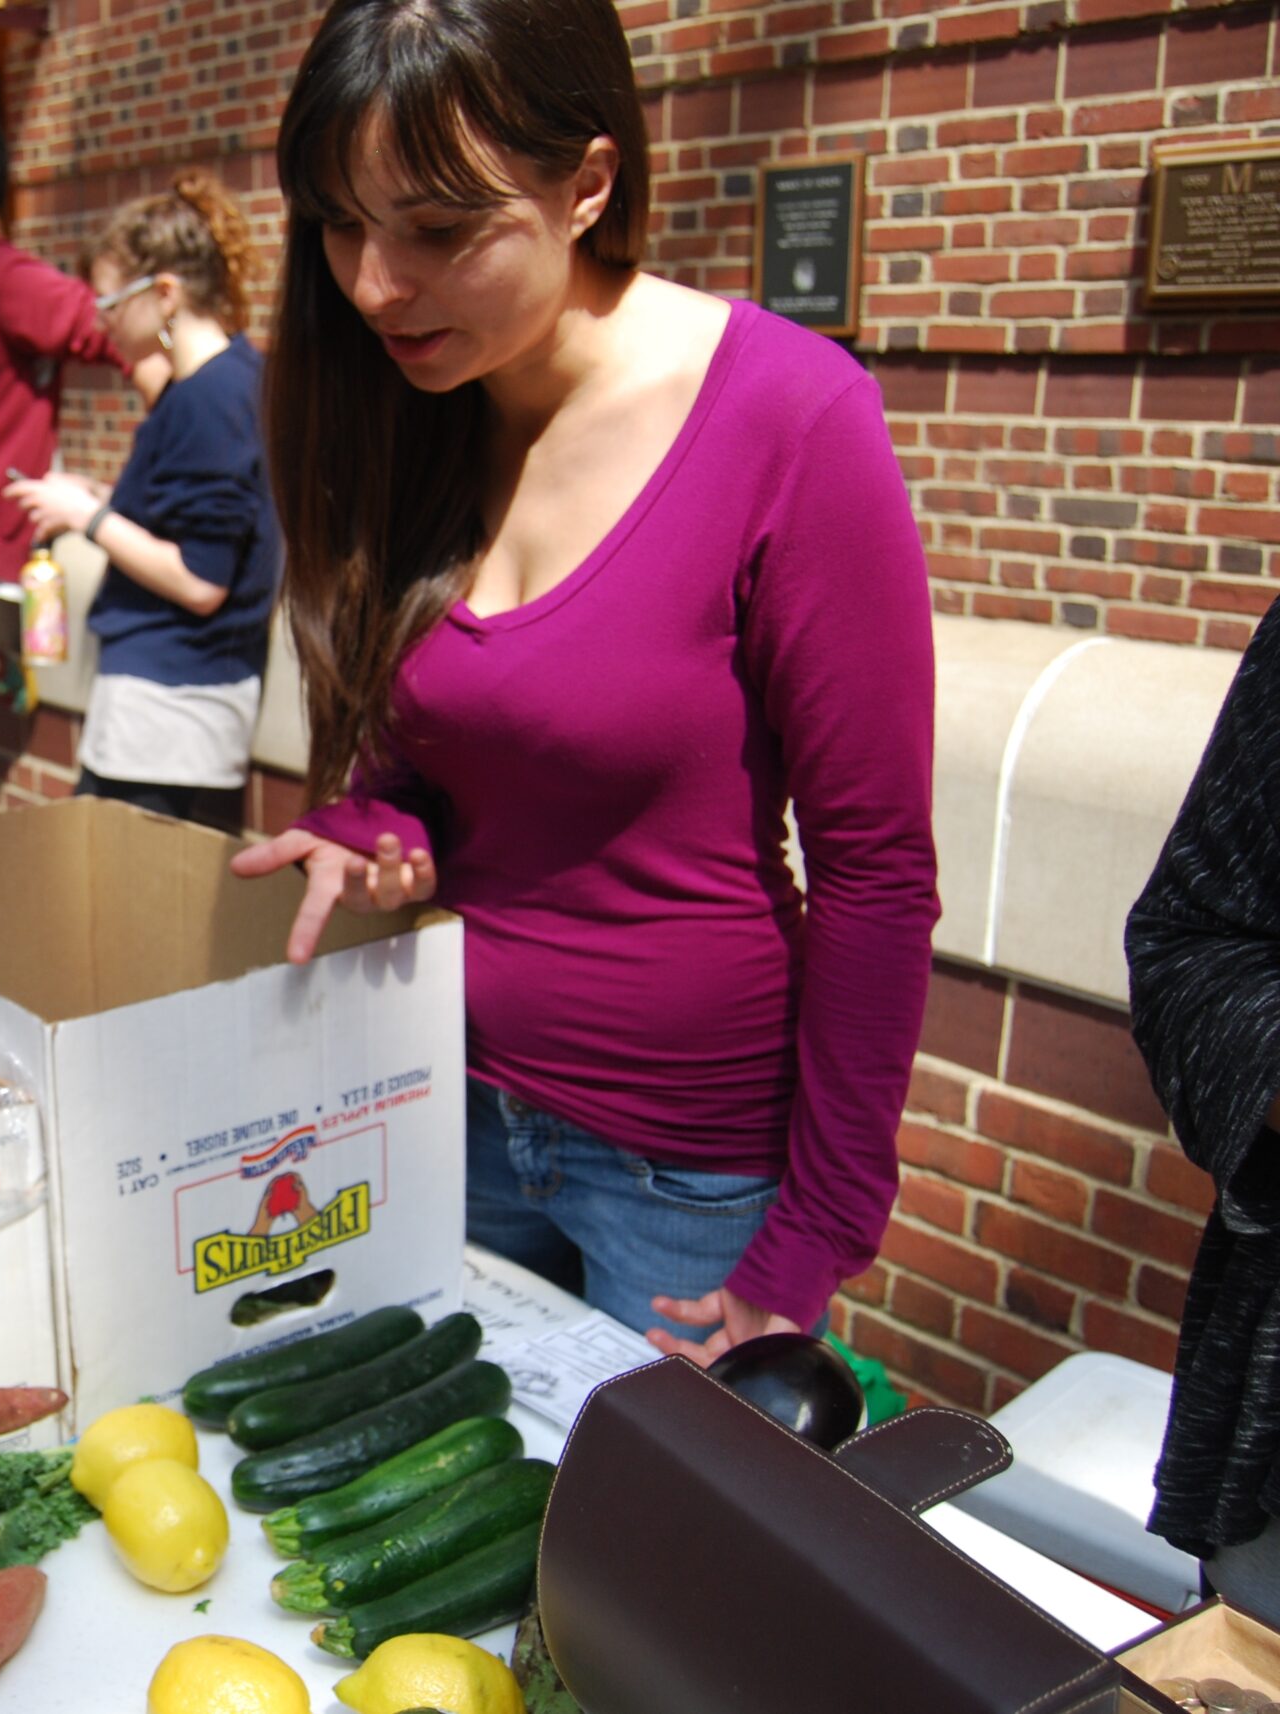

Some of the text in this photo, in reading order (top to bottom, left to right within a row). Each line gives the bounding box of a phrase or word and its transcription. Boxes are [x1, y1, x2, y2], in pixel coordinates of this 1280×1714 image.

[371, 1081, 384, 1099] OF
[387, 1065, 432, 1094] PRODUCE
[276, 1109, 299, 1129] ONE
[322, 1083, 432, 1131] PREMIUM APPLES
[186, 1128, 229, 1156] BUSHEL
[232, 1116, 273, 1145] VOLUME
[117, 1157, 142, 1180] SIZE
[119, 1173, 158, 1197] CAT 1
